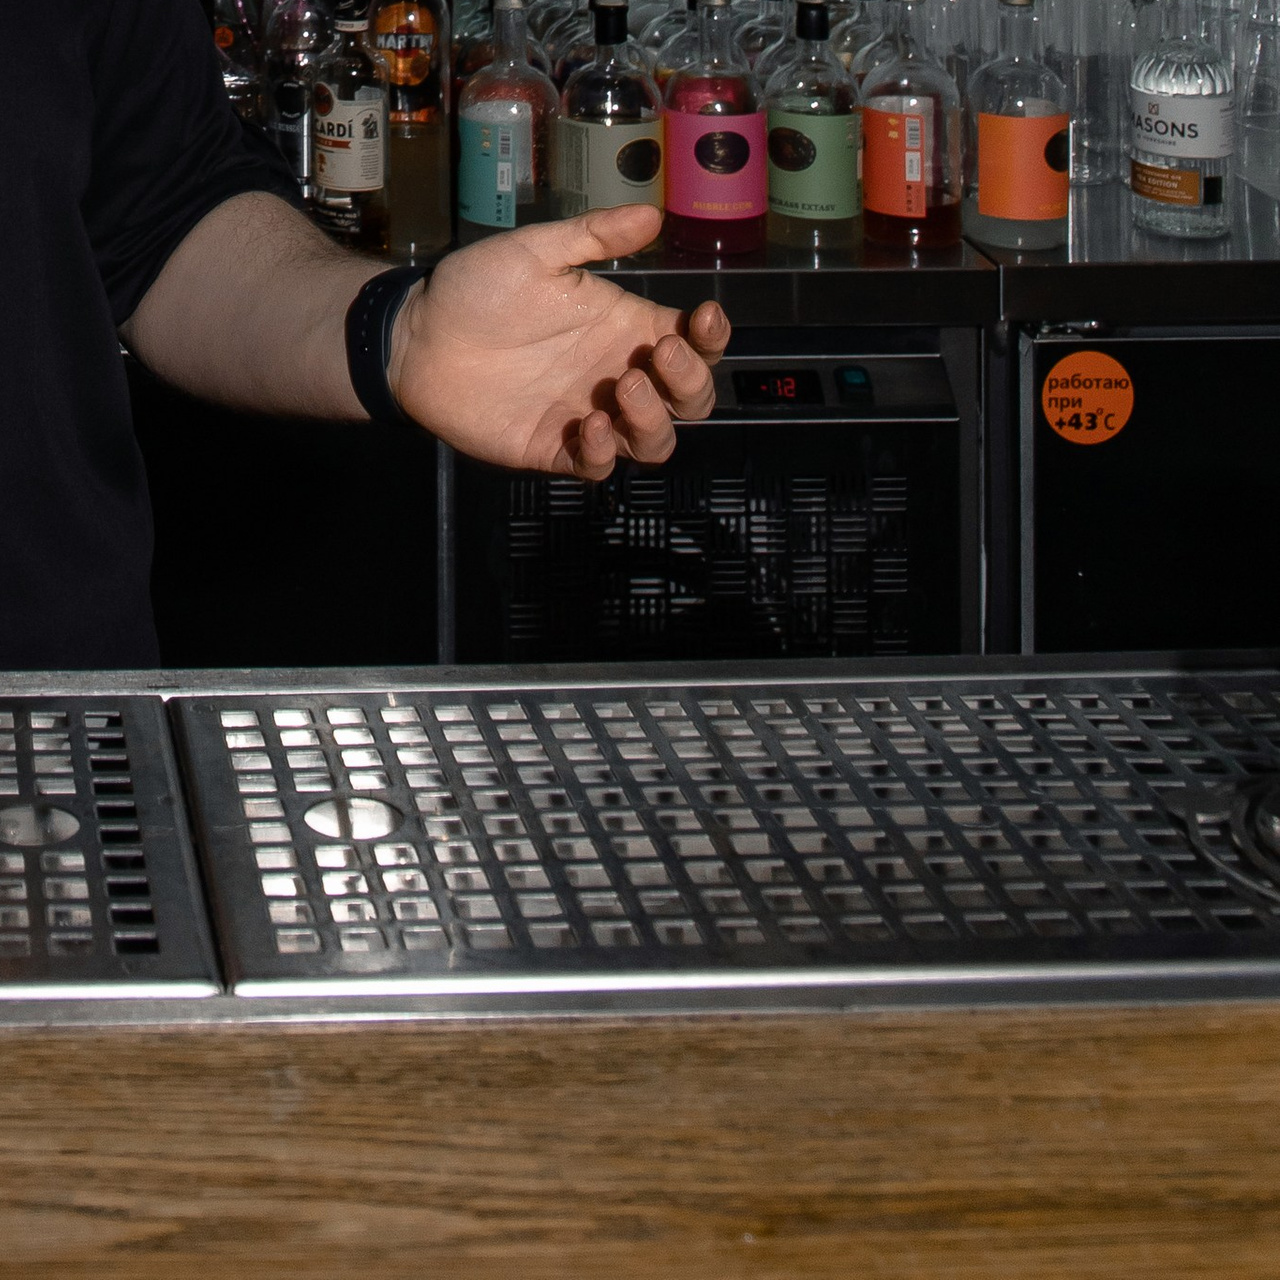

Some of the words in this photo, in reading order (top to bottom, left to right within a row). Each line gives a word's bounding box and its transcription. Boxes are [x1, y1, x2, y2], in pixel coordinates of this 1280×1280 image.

[1148, 178, 1178, 188] EDITION
[1048, 373, 1130, 394] работаю
[1048, 397, 1083, 412] при
